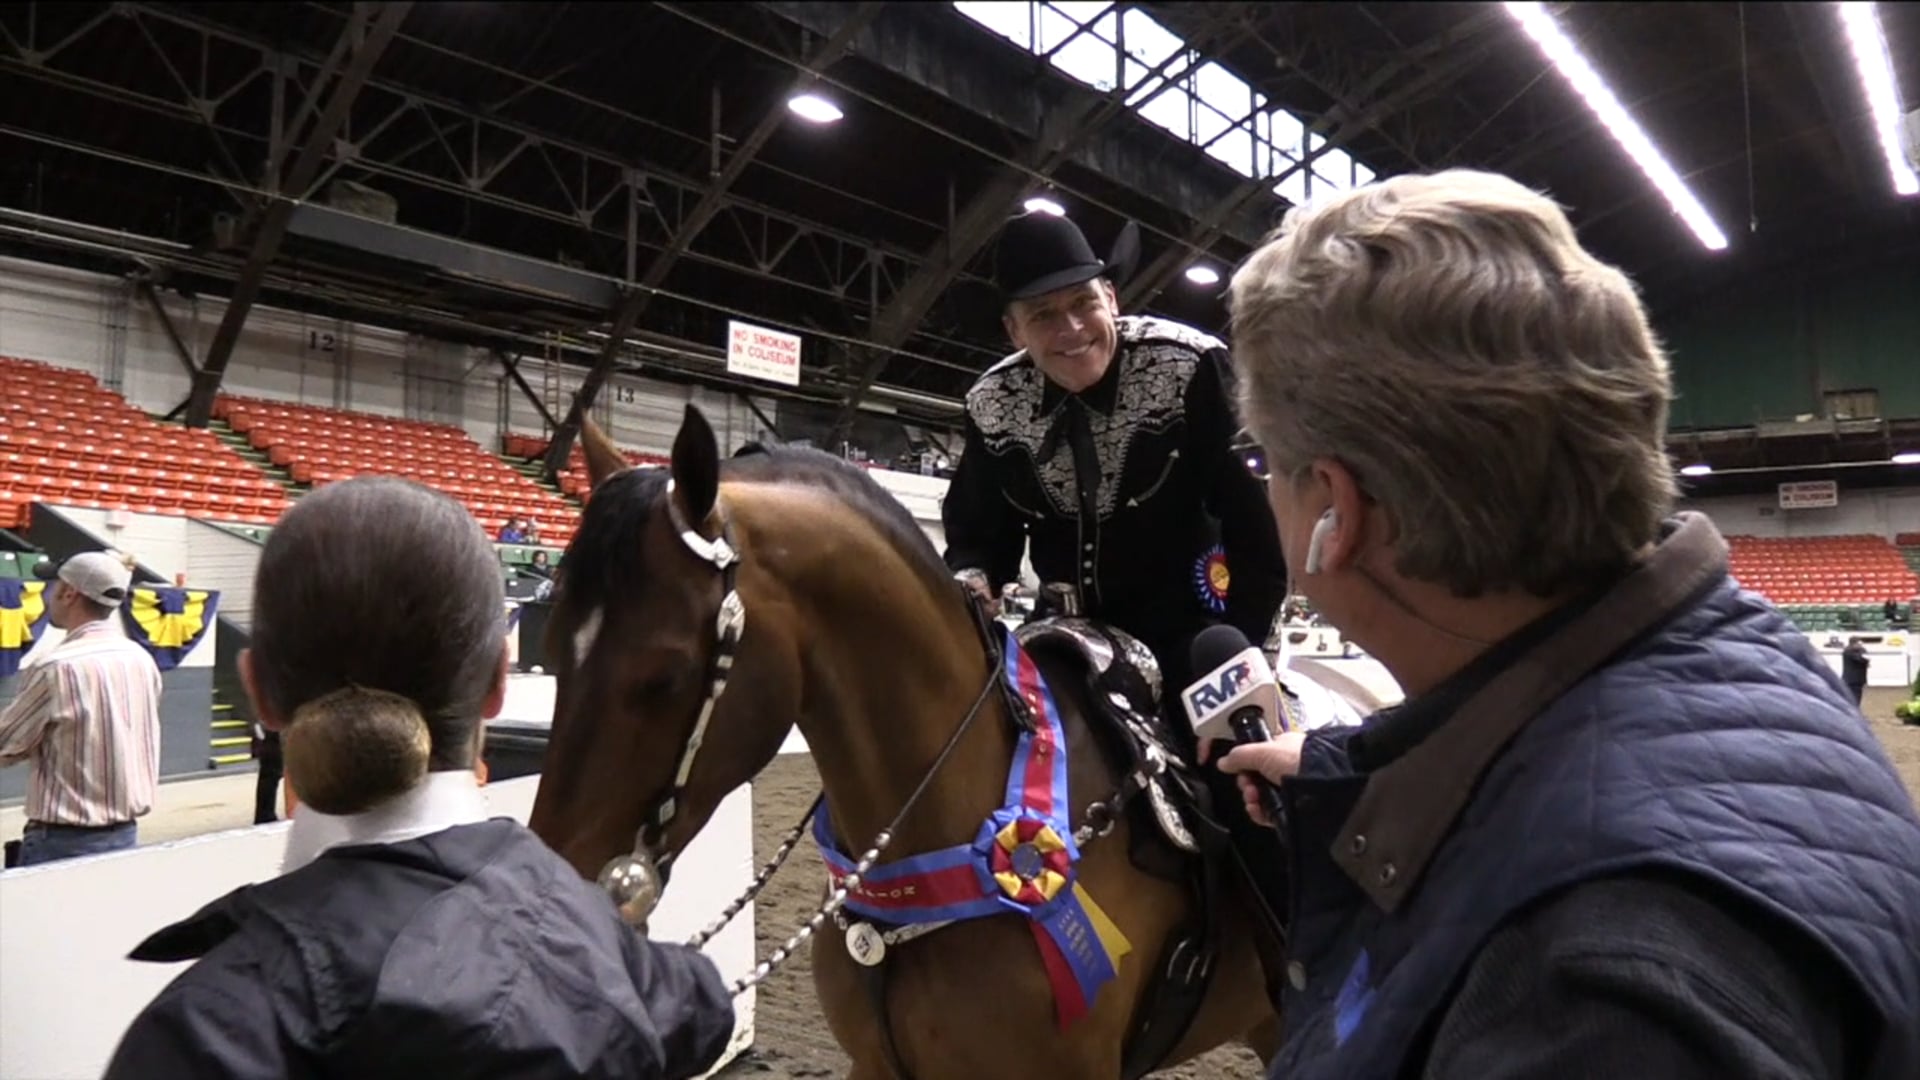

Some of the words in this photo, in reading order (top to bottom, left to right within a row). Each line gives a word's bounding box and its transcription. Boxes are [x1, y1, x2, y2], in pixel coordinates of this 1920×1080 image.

[310, 331, 334, 352] 12
[734, 329, 748, 341] NO
[754, 333, 796, 352] SMOKING
[733, 343, 743, 354] IN
[748, 345, 796, 366] COLISEUM
[616, 385, 634, 404] 13
